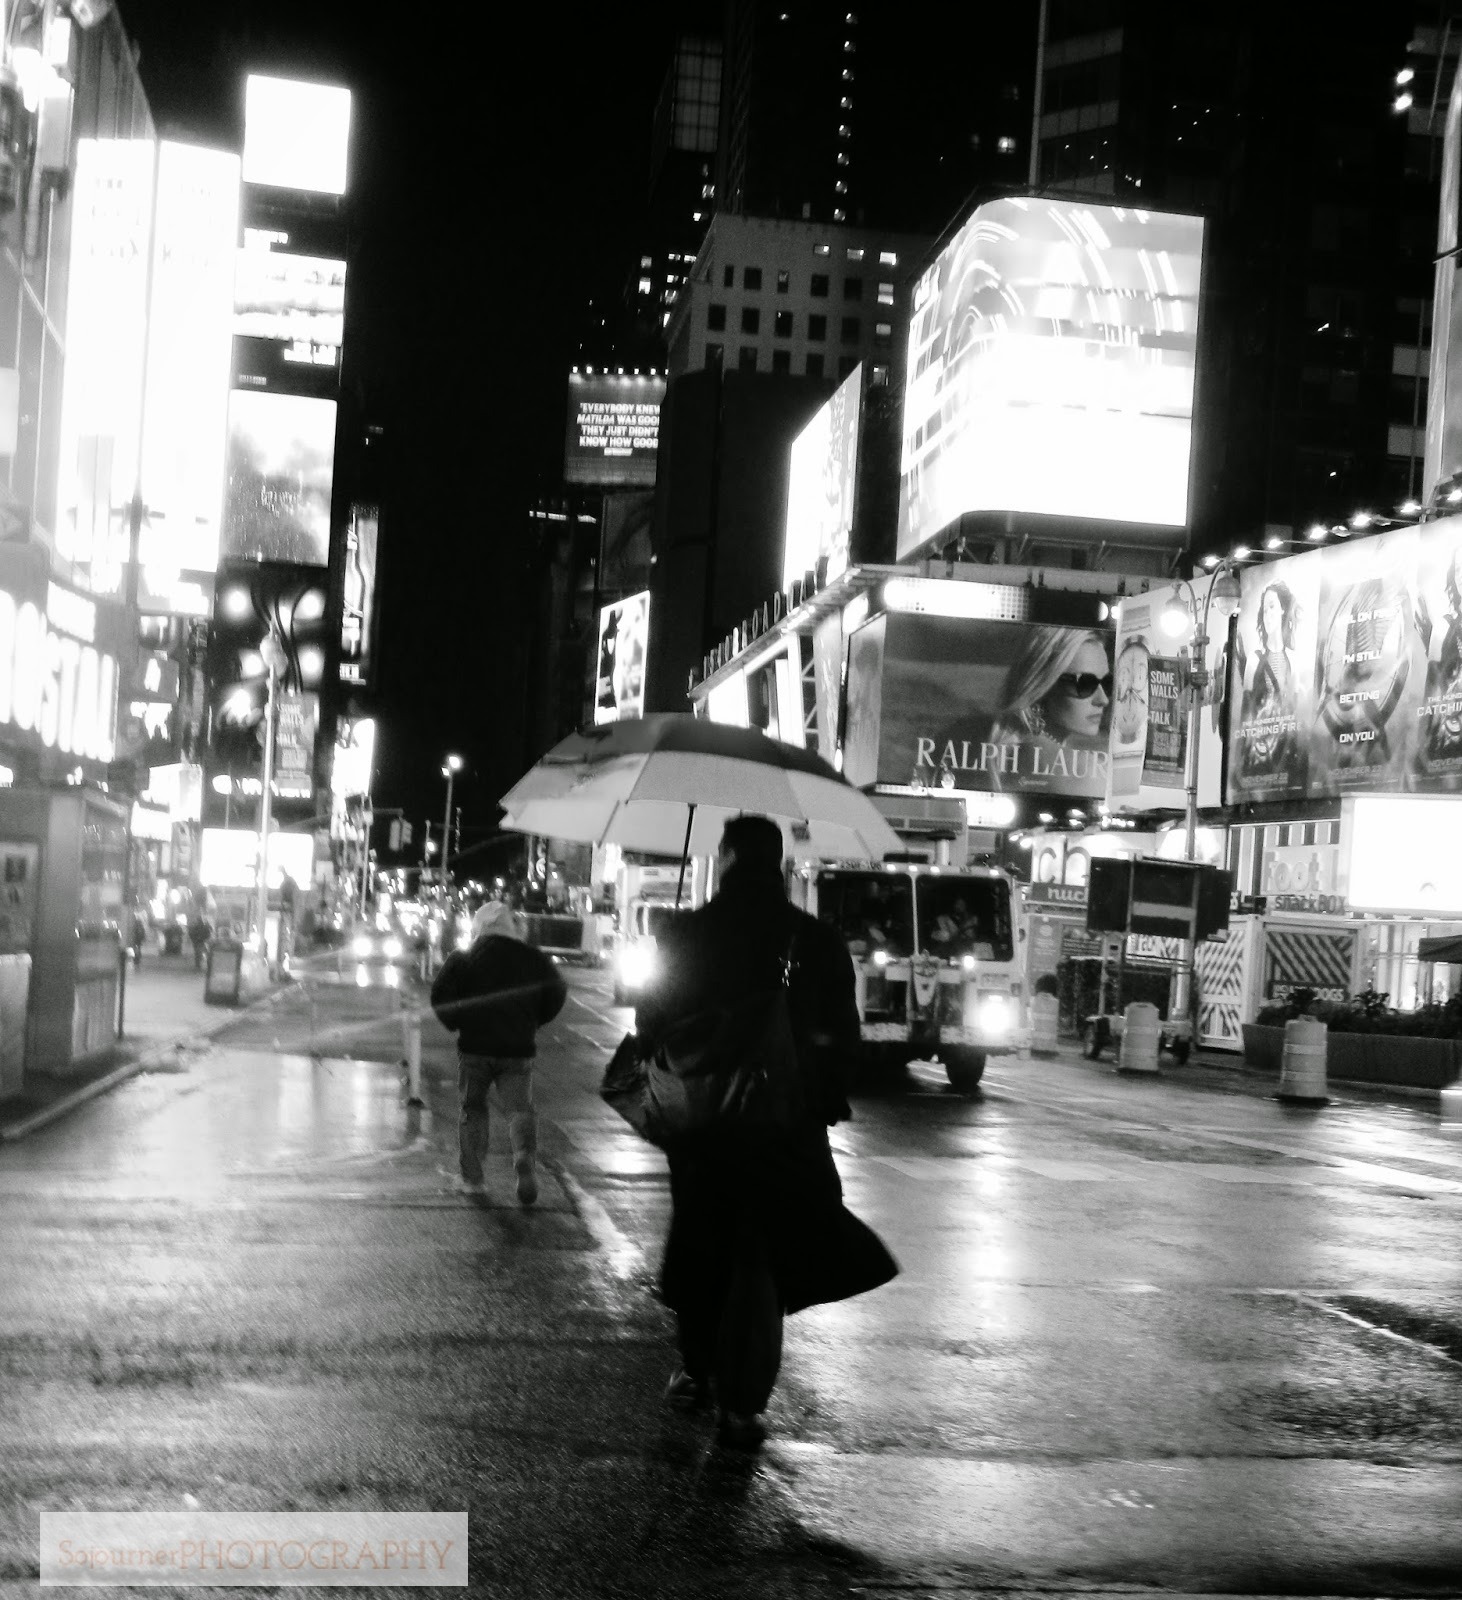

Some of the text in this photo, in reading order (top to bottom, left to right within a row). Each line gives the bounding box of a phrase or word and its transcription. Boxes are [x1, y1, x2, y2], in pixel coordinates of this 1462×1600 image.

[577, 414, 615, 424] MATILDA
[617, 415, 637, 425] WAS
[582, 425, 659, 437] THEY JUST DIDN'T
[580, 436, 608, 447] KNOW
[610, 436, 632, 448] HOW
[1150, 670, 1175, 686] SOME
[1151, 684, 1179, 698] WALLS
[1340, 690, 1380, 703] BETTING
[1150, 710, 1170, 725] TALK
[1234, 725, 1279, 739] CATCHING
[1339, 731, 1375, 743] ON YOU
[916, 737, 1020, 773] RALPH
